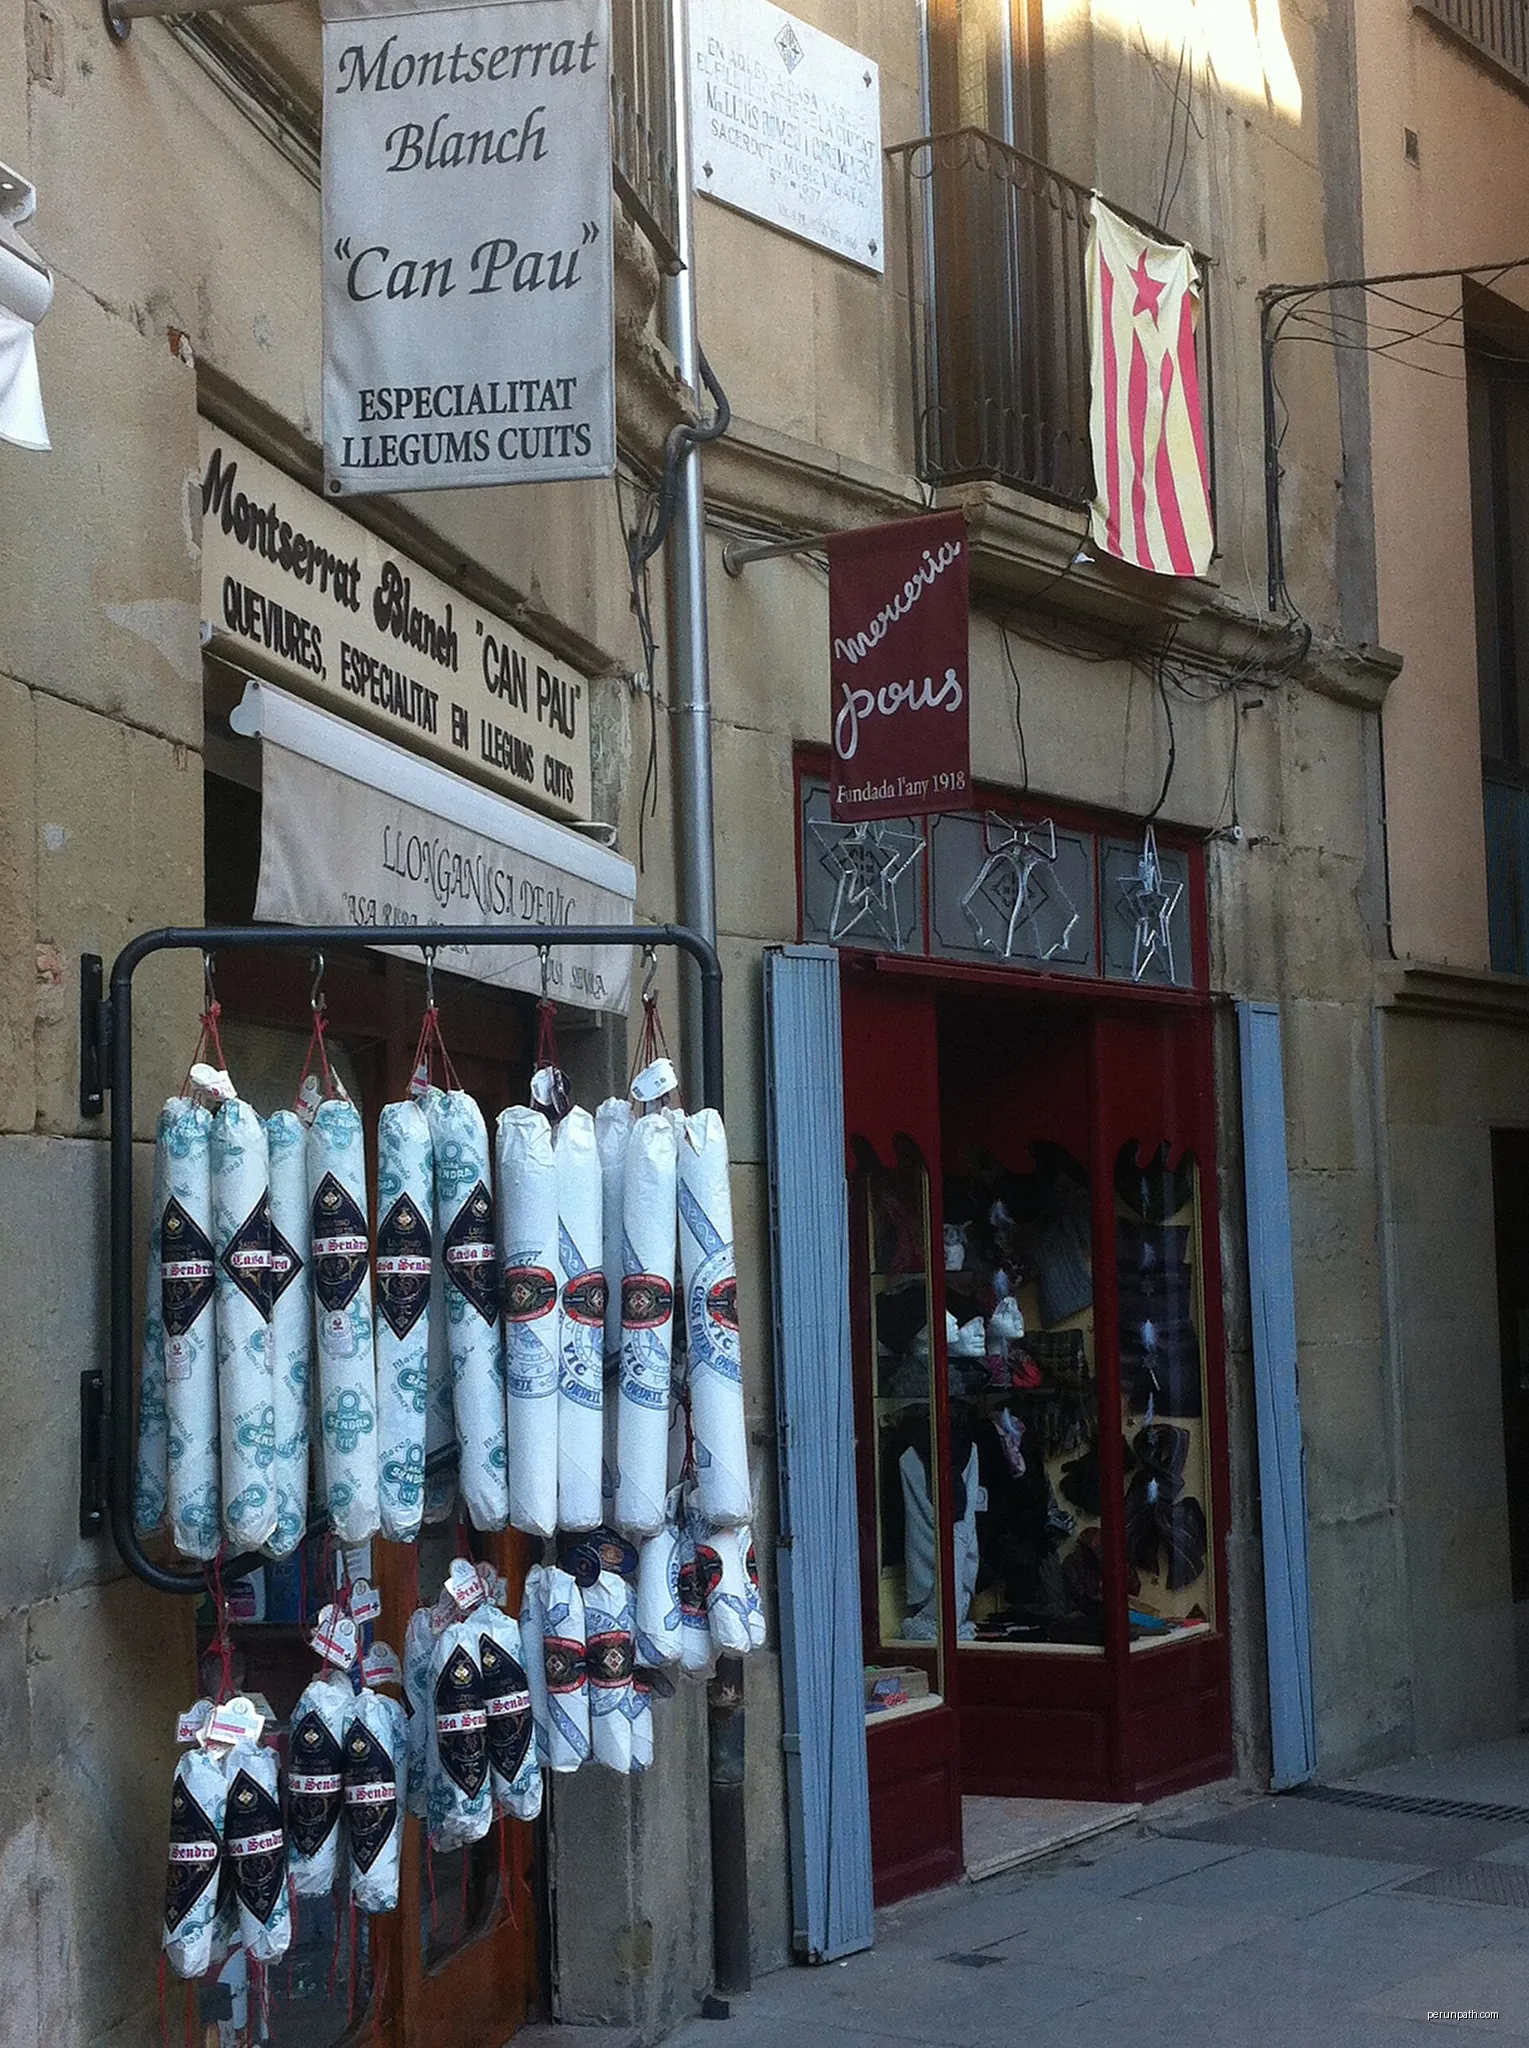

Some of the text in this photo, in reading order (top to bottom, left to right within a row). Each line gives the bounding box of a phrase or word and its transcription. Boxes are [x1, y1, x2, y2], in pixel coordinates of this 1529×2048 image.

[335, 30, 599, 94] Montserrat
[385, 105, 548, 172] Blanch
[357, 377, 577, 422] ESPECIALITAT
[340, 423, 591, 468] LLEGUMS CUITS
[201, 448, 361, 612] Montserrat
[373, 561, 458, 672] Blanch
[223, 576, 574, 803] QUEVIURES, ESPECIALITAT EN LLEGUMS CUITS
[835, 668, 963, 760] pous
[836, 770, 965, 803] Fundada l'any 1918
[520, 880, 545, 925] DE
[564, 1341, 587, 1376] VIC
[624, 1342, 646, 1376] VIC
